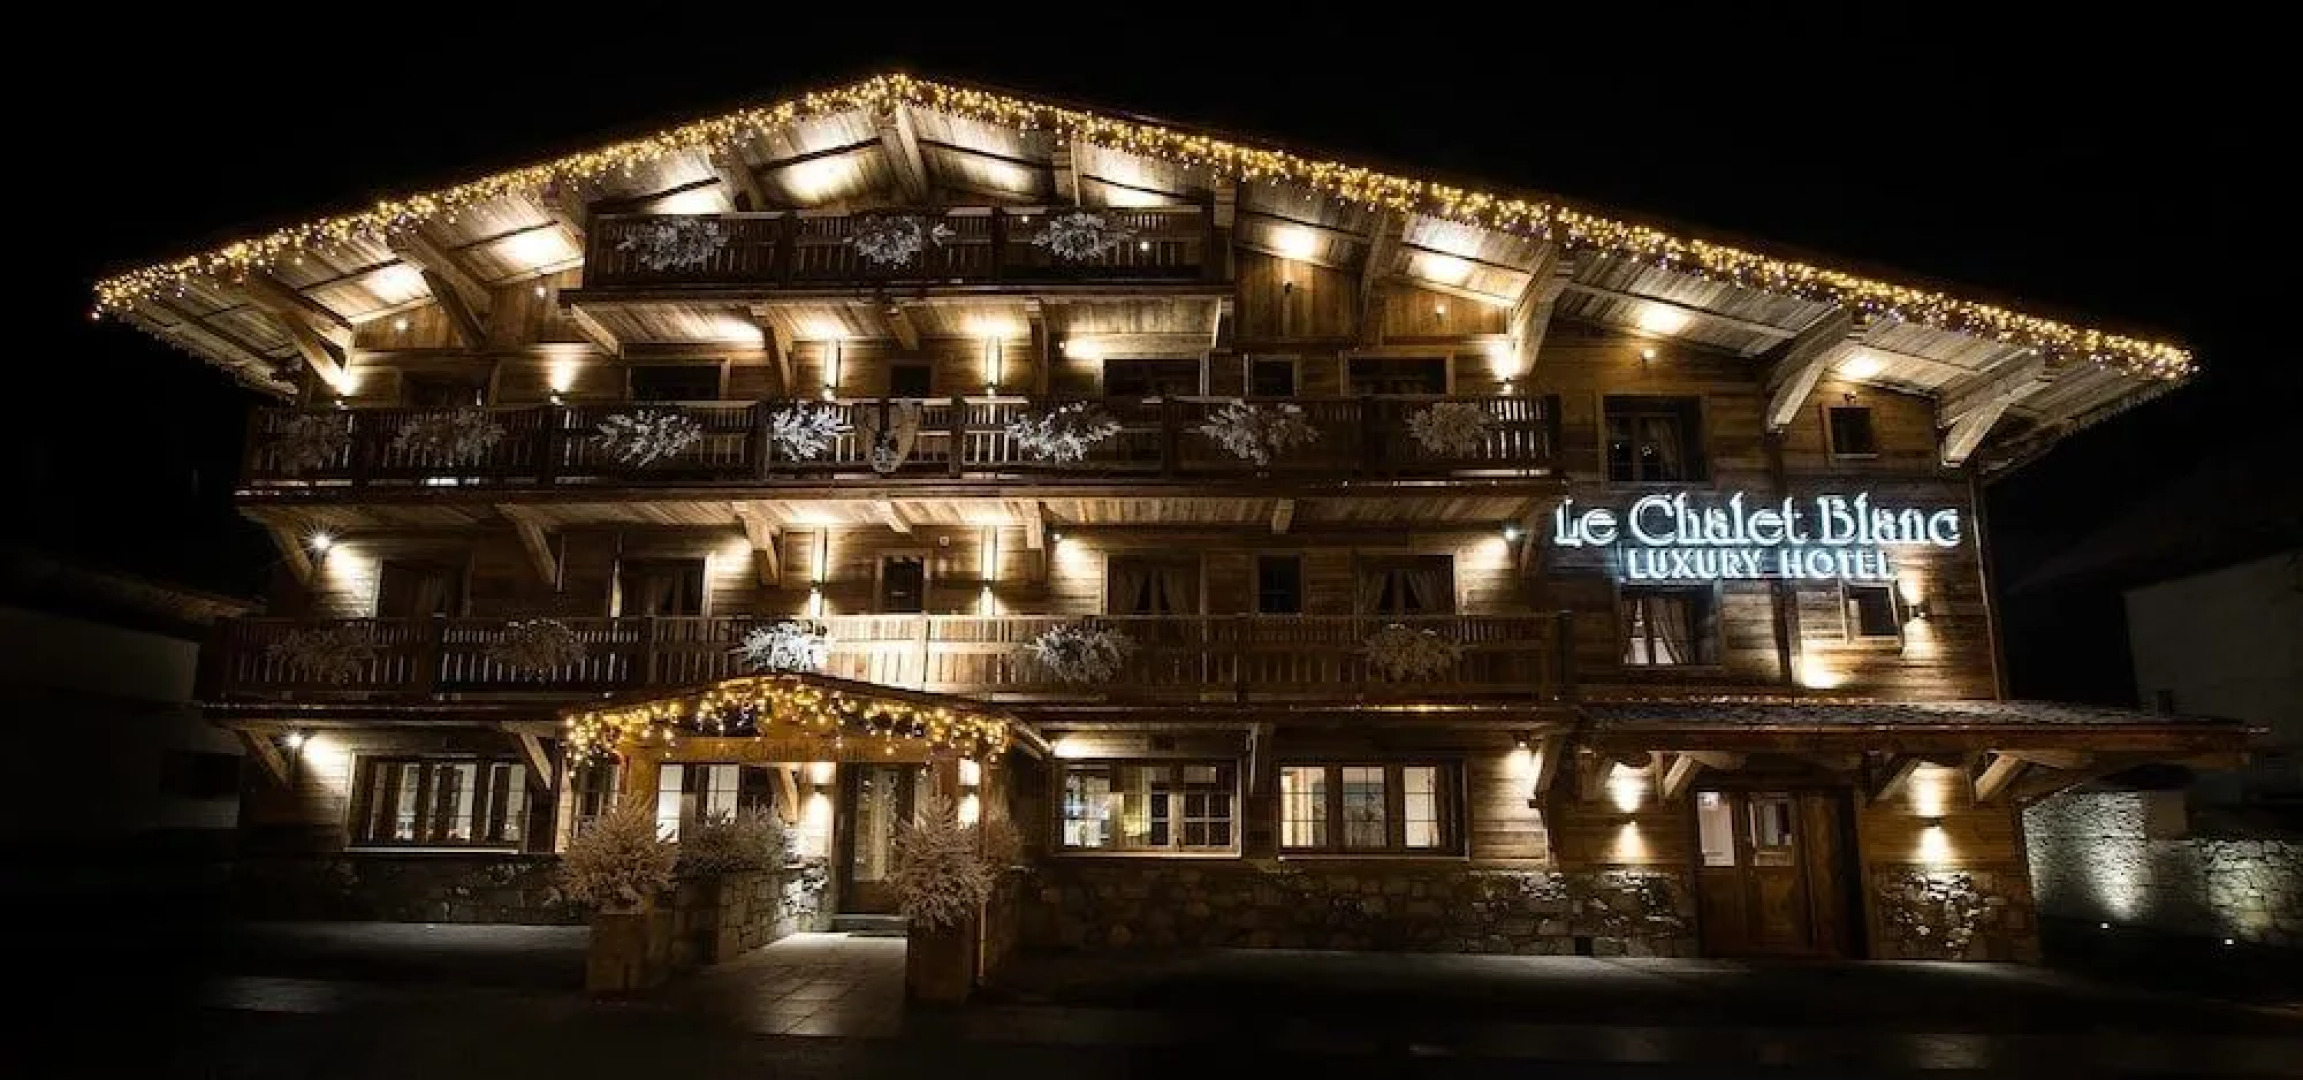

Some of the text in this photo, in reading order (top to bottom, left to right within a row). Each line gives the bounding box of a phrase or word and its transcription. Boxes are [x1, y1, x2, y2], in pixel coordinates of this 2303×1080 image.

[1554, 491, 1961, 547] Le Chalet Blanc
[1629, 547, 1894, 579] LUXURY HOTEL
